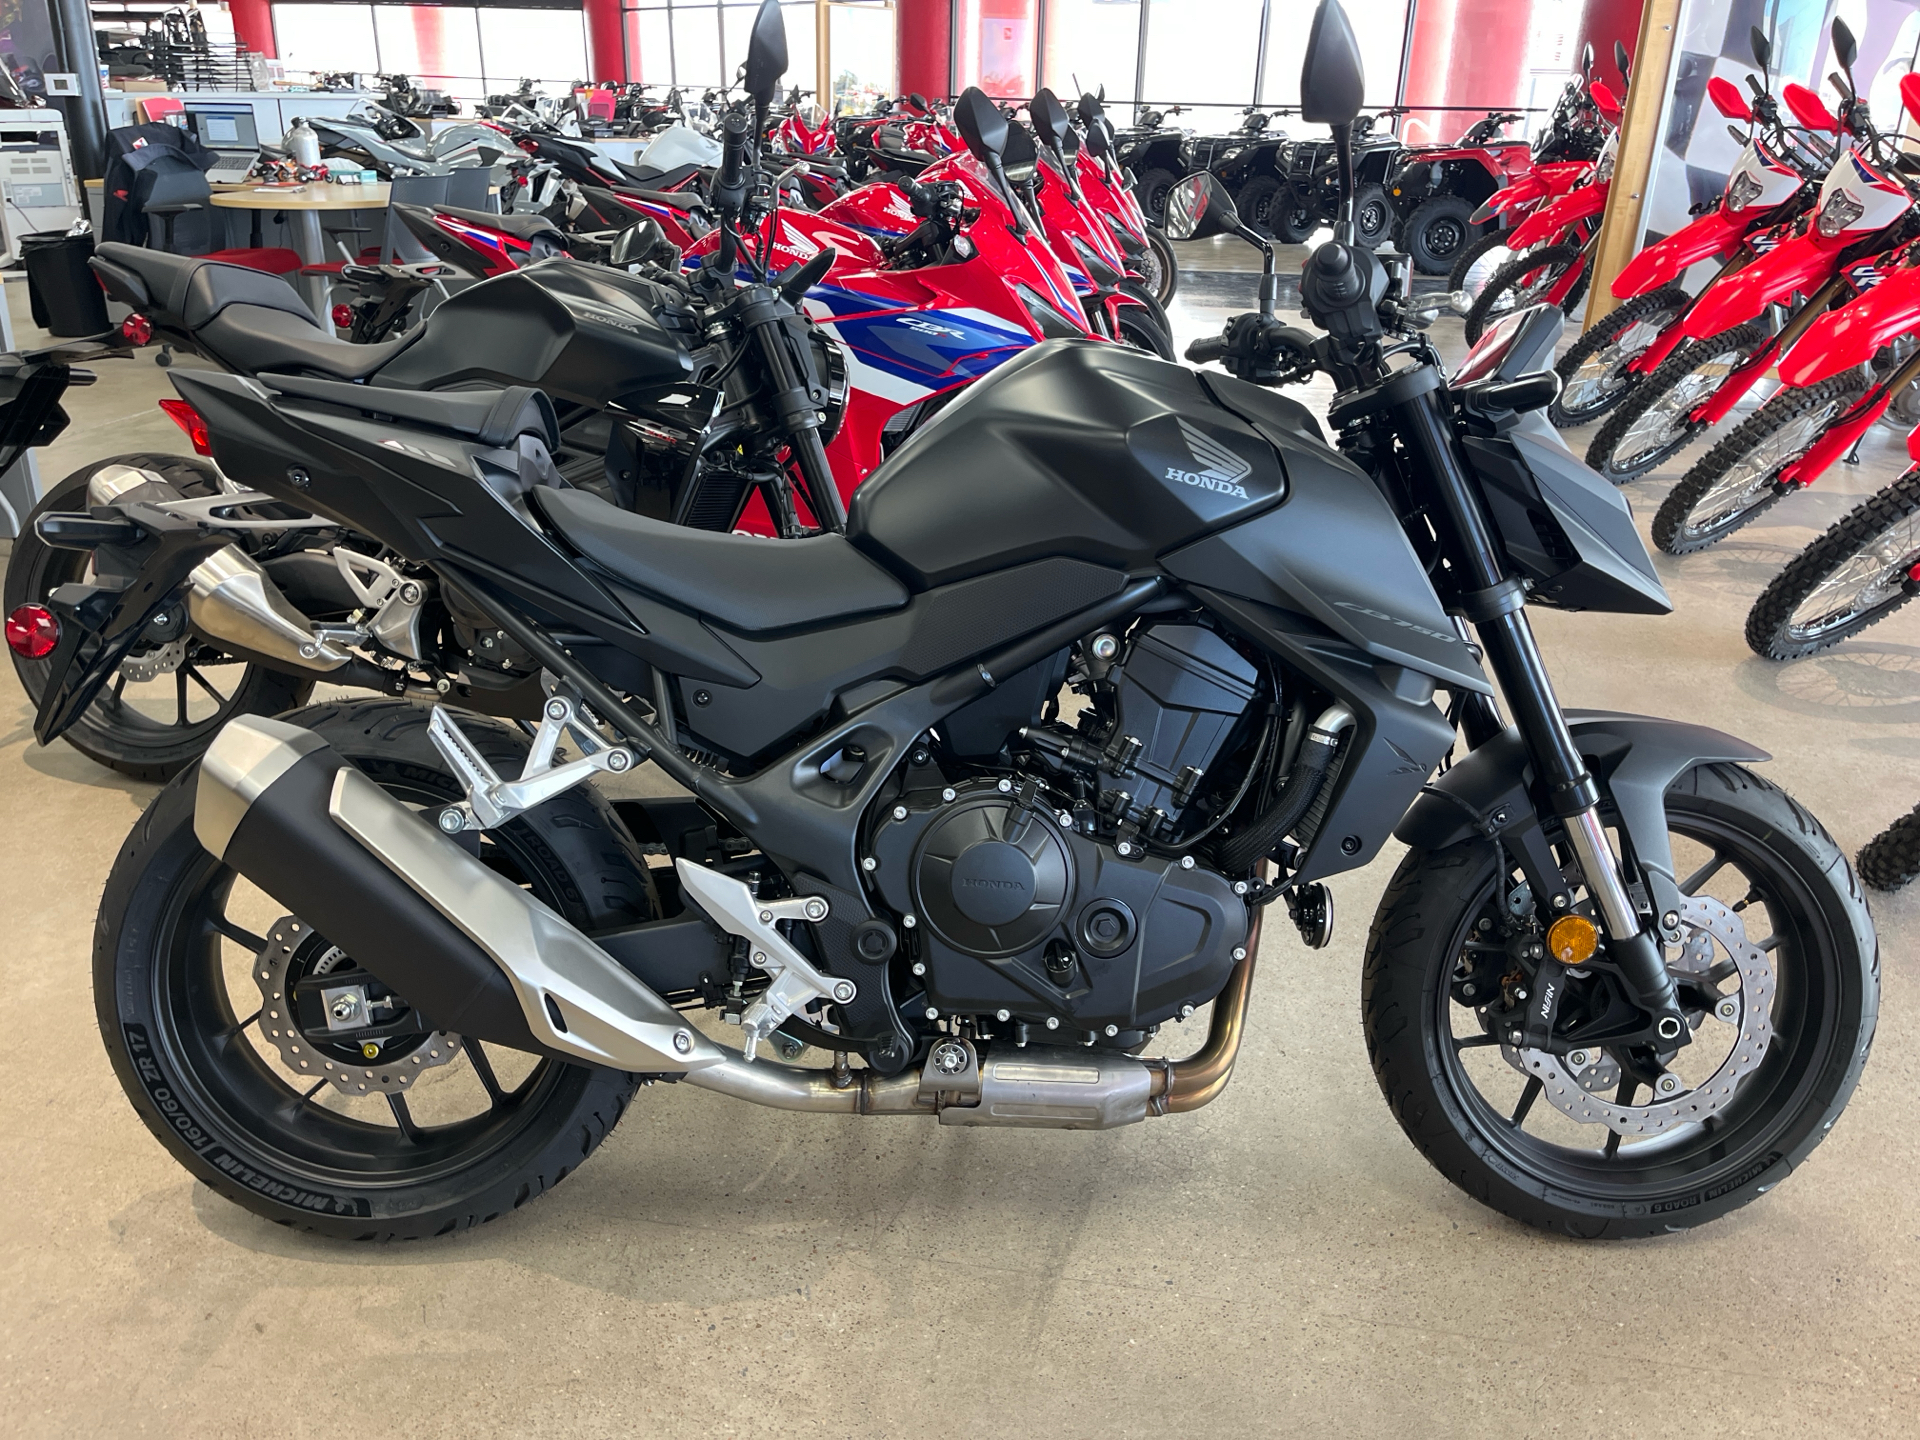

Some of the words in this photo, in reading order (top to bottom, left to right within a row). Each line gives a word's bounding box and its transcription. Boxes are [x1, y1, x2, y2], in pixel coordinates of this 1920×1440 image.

[583, 311, 639, 334] HONDA
[896, 317, 966, 341] CBR
[1165, 467, 1250, 500] HONDA
[1334, 602, 1456, 642] CB750
[962, 878, 1025, 890] HONDA
[128, 1031, 147, 1052] 17
[138, 1057, 161, 1082] ZR
[154, 1087, 208, 1147] 160/60
[213, 1152, 330, 1211] MICHELIN
[1708, 1163, 1763, 1199] MICHELIN
[1665, 1195, 1697, 1213] ROAD
